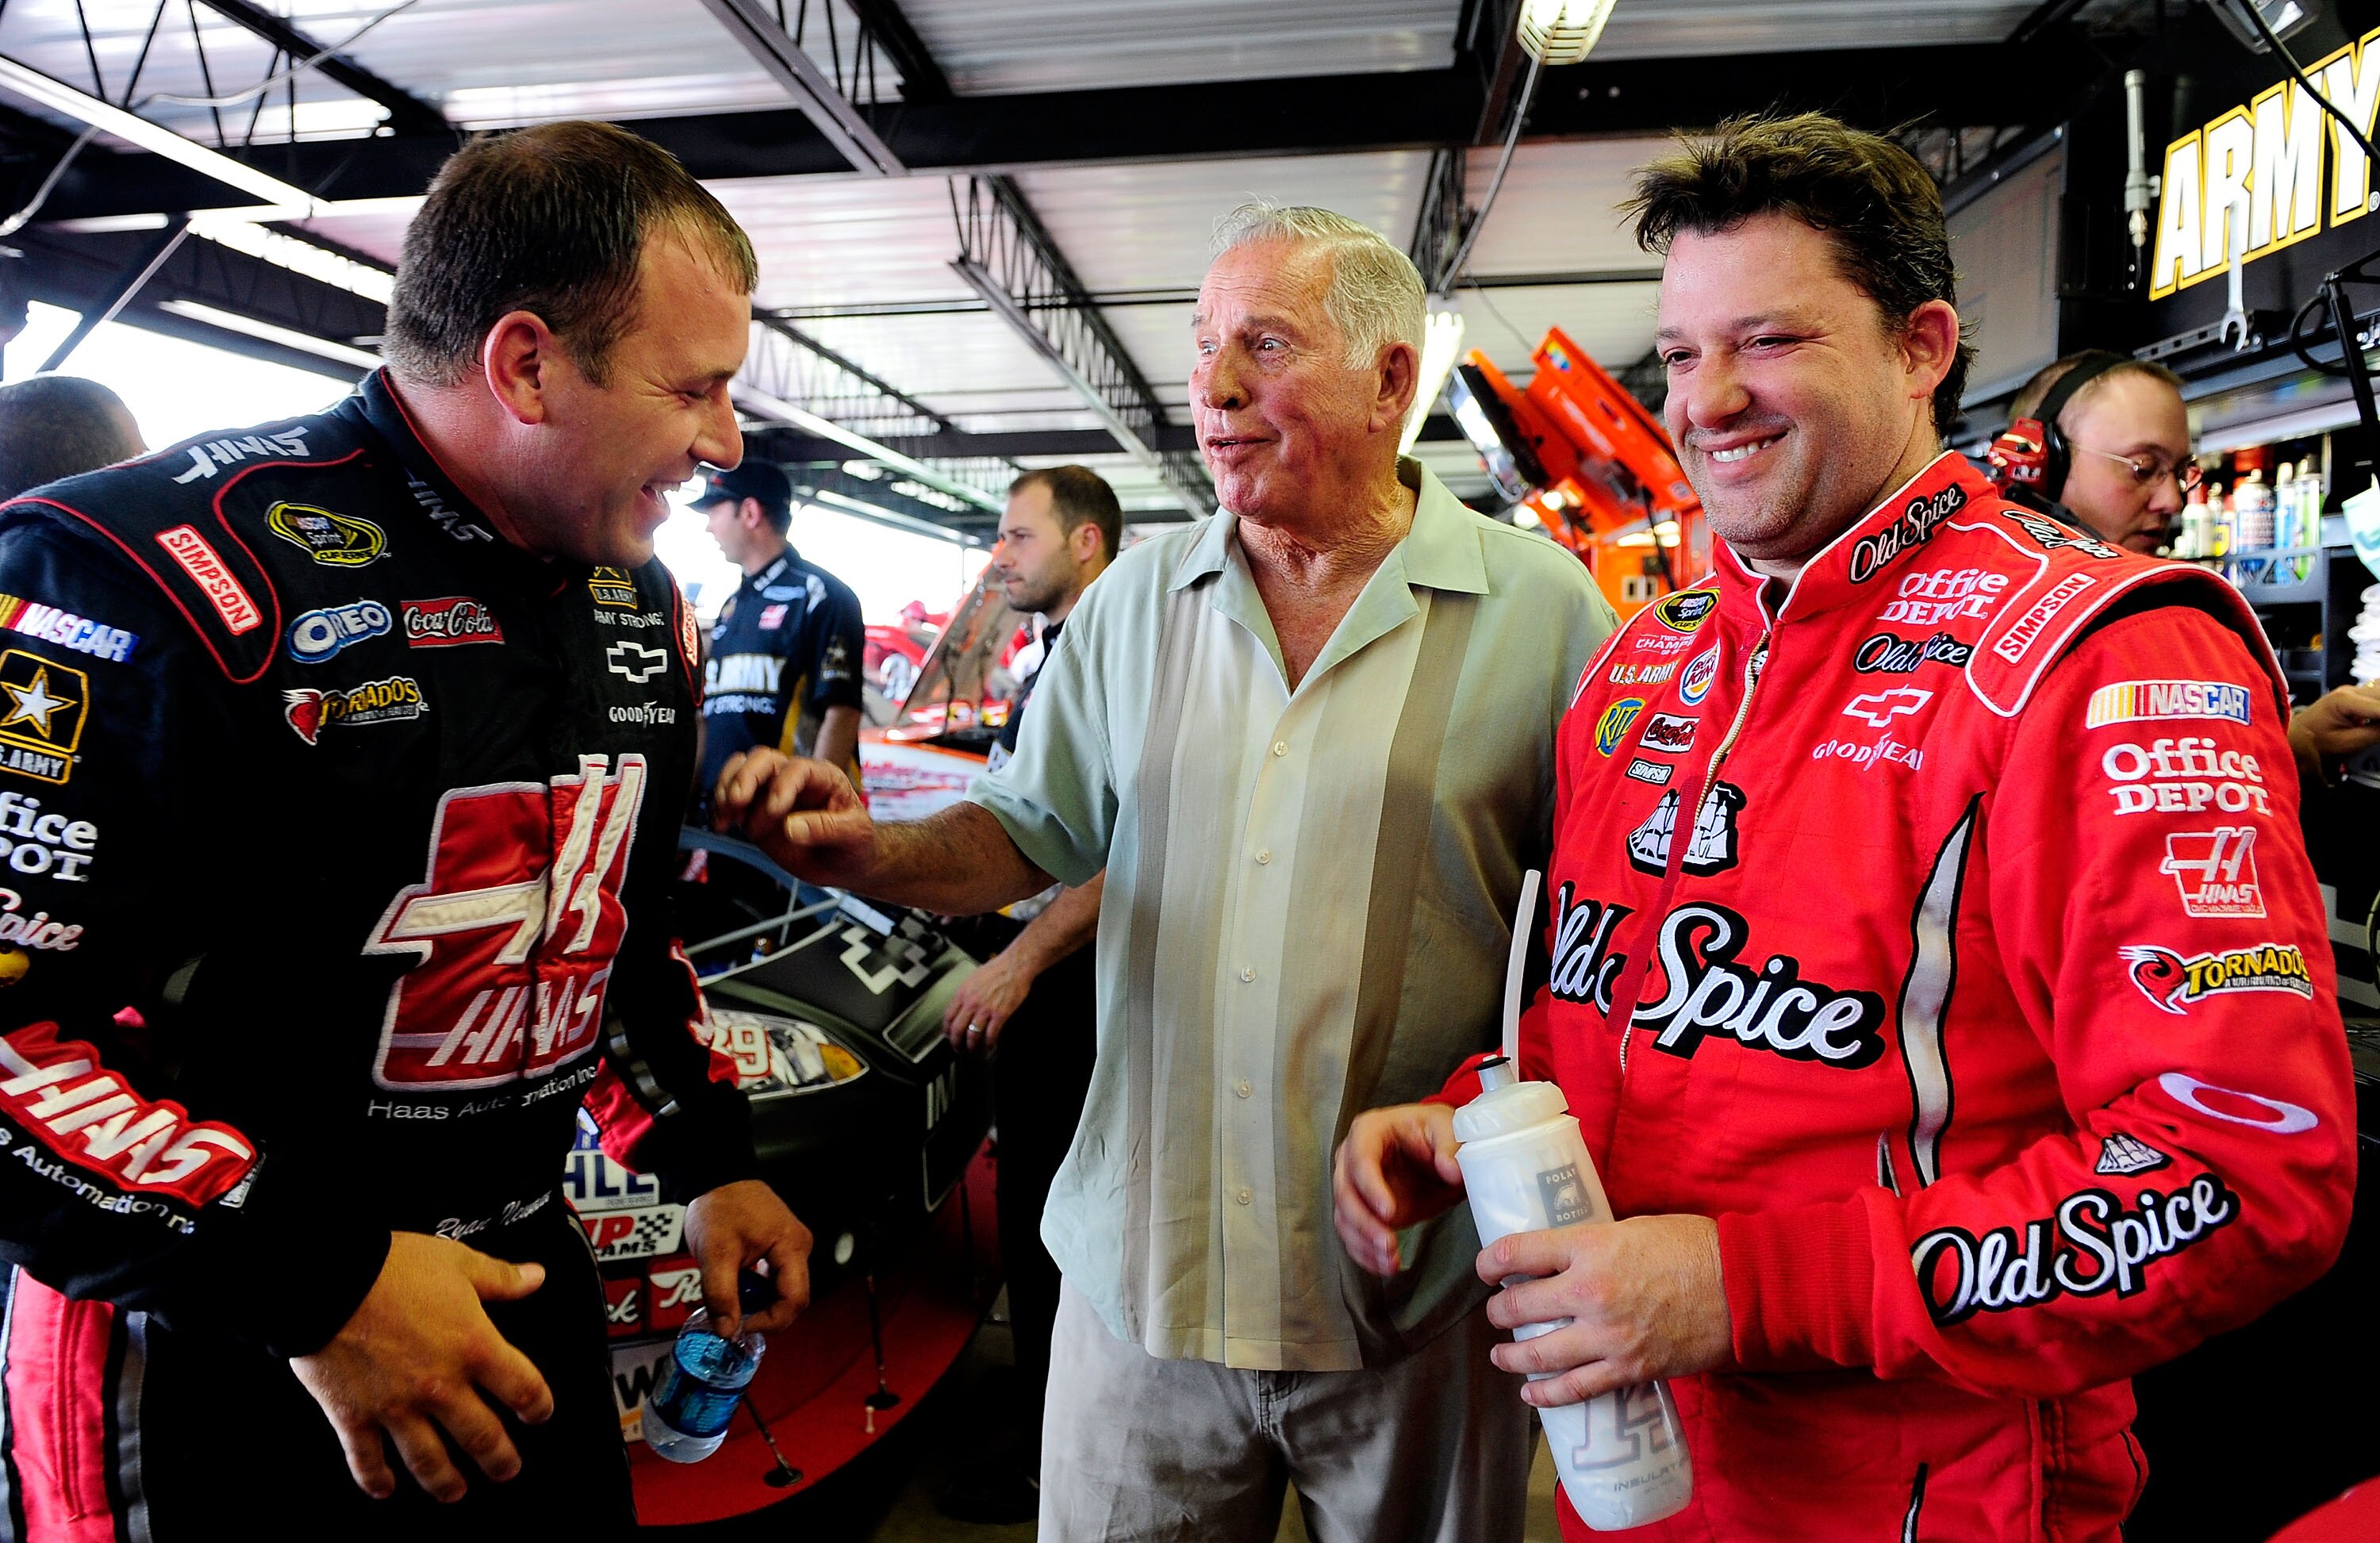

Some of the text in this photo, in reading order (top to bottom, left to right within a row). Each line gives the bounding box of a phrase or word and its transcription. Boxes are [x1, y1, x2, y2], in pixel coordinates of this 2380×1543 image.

[2149, 28, 2380, 301] ARMY
[305, 530, 344, 547] Sprint
[1851, 487, 1963, 582] Old Spice
[169, 531, 253, 630] SIMPSON
[14, 602, 133, 662] NASCAR
[293, 605, 386, 653] OREO
[403, 601, 494, 639] Coca-Cola
[1678, 605, 1706, 619] Sprint
[2000, 575, 2090, 658] SIMPSON
[1608, 658, 1683, 684] U.S. ARMY
[2149, 684, 2245, 720] NASCAR
[8, 749, 64, 777] ARMY
[2102, 737, 2263, 783] Office
[2108, 781, 2274, 816] DEPOT
[1595, 907, 1864, 1059] Spice
[367, 1099, 450, 1120] Haas
[11, 1145, 170, 1218] Automation
[1911, 1178, 2229, 1320] Old Spice
